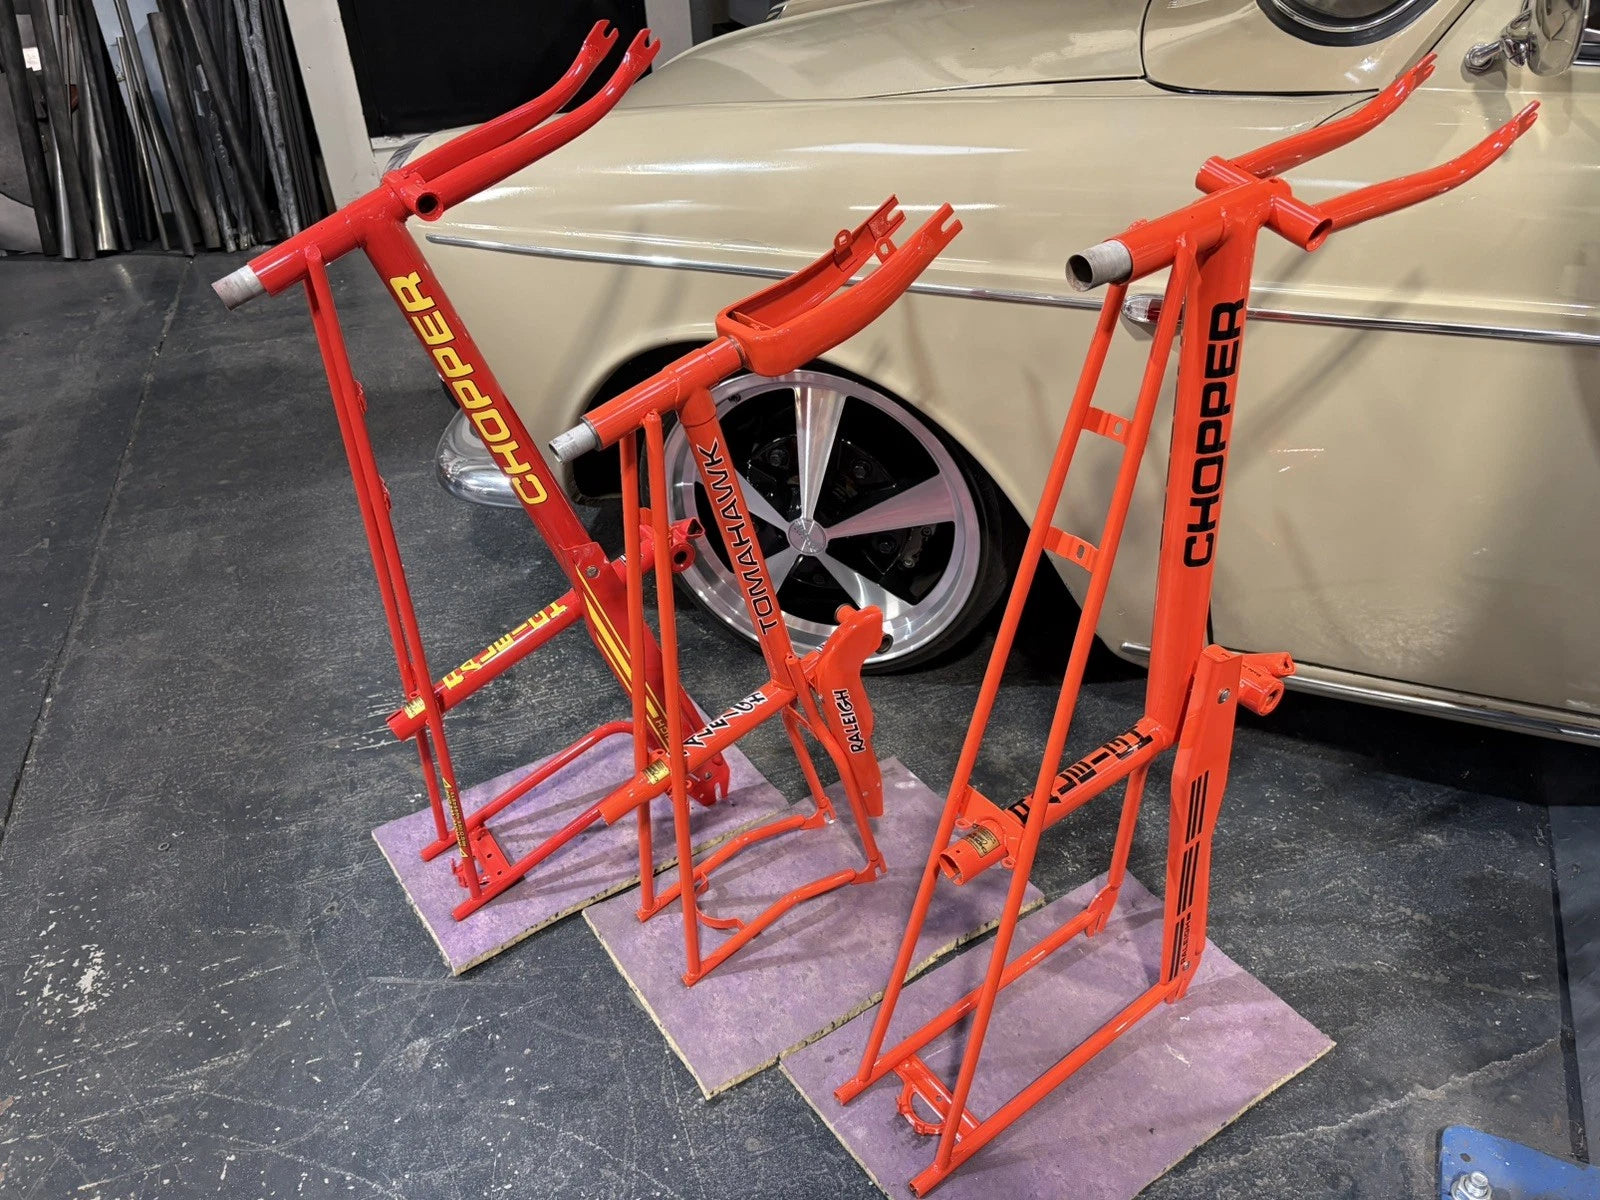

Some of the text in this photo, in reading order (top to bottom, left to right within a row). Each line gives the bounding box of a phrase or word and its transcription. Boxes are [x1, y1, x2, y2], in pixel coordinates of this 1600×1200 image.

[388, 270, 549, 506] CHOPPER
[1183, 298, 1245, 568] CHOPPER
[697, 437, 778, 635] TOMAHAWK
[666, 690, 768, 757] ALEIGH
[832, 688, 866, 754] RALEIGH
